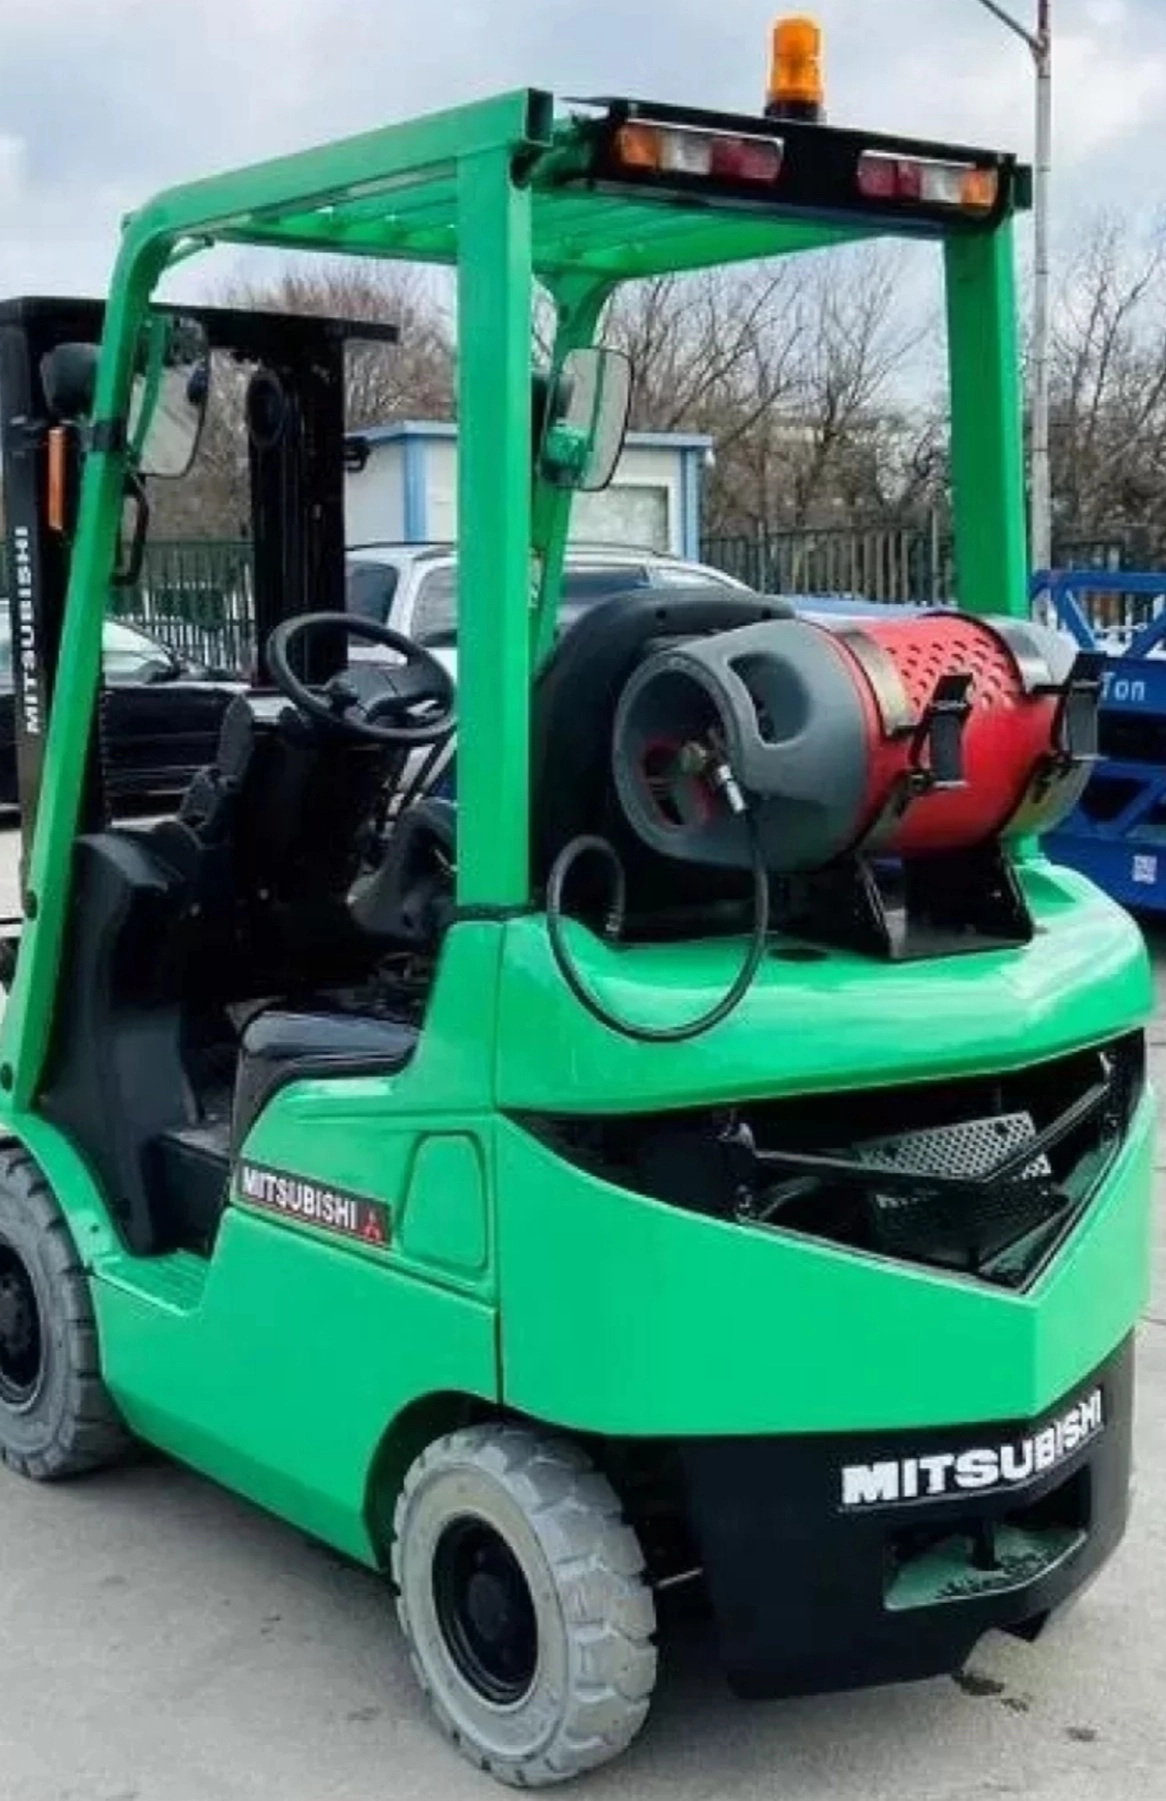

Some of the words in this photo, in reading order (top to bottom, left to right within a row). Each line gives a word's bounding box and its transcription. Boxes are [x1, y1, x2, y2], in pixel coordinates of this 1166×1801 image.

[14, 526, 40, 733] MITSUBISHI
[1101, 671, 1146, 701] Ton
[242, 1166, 356, 1230] MITSUBISHI
[842, 1389, 1102, 1504] MITSUBISHI
